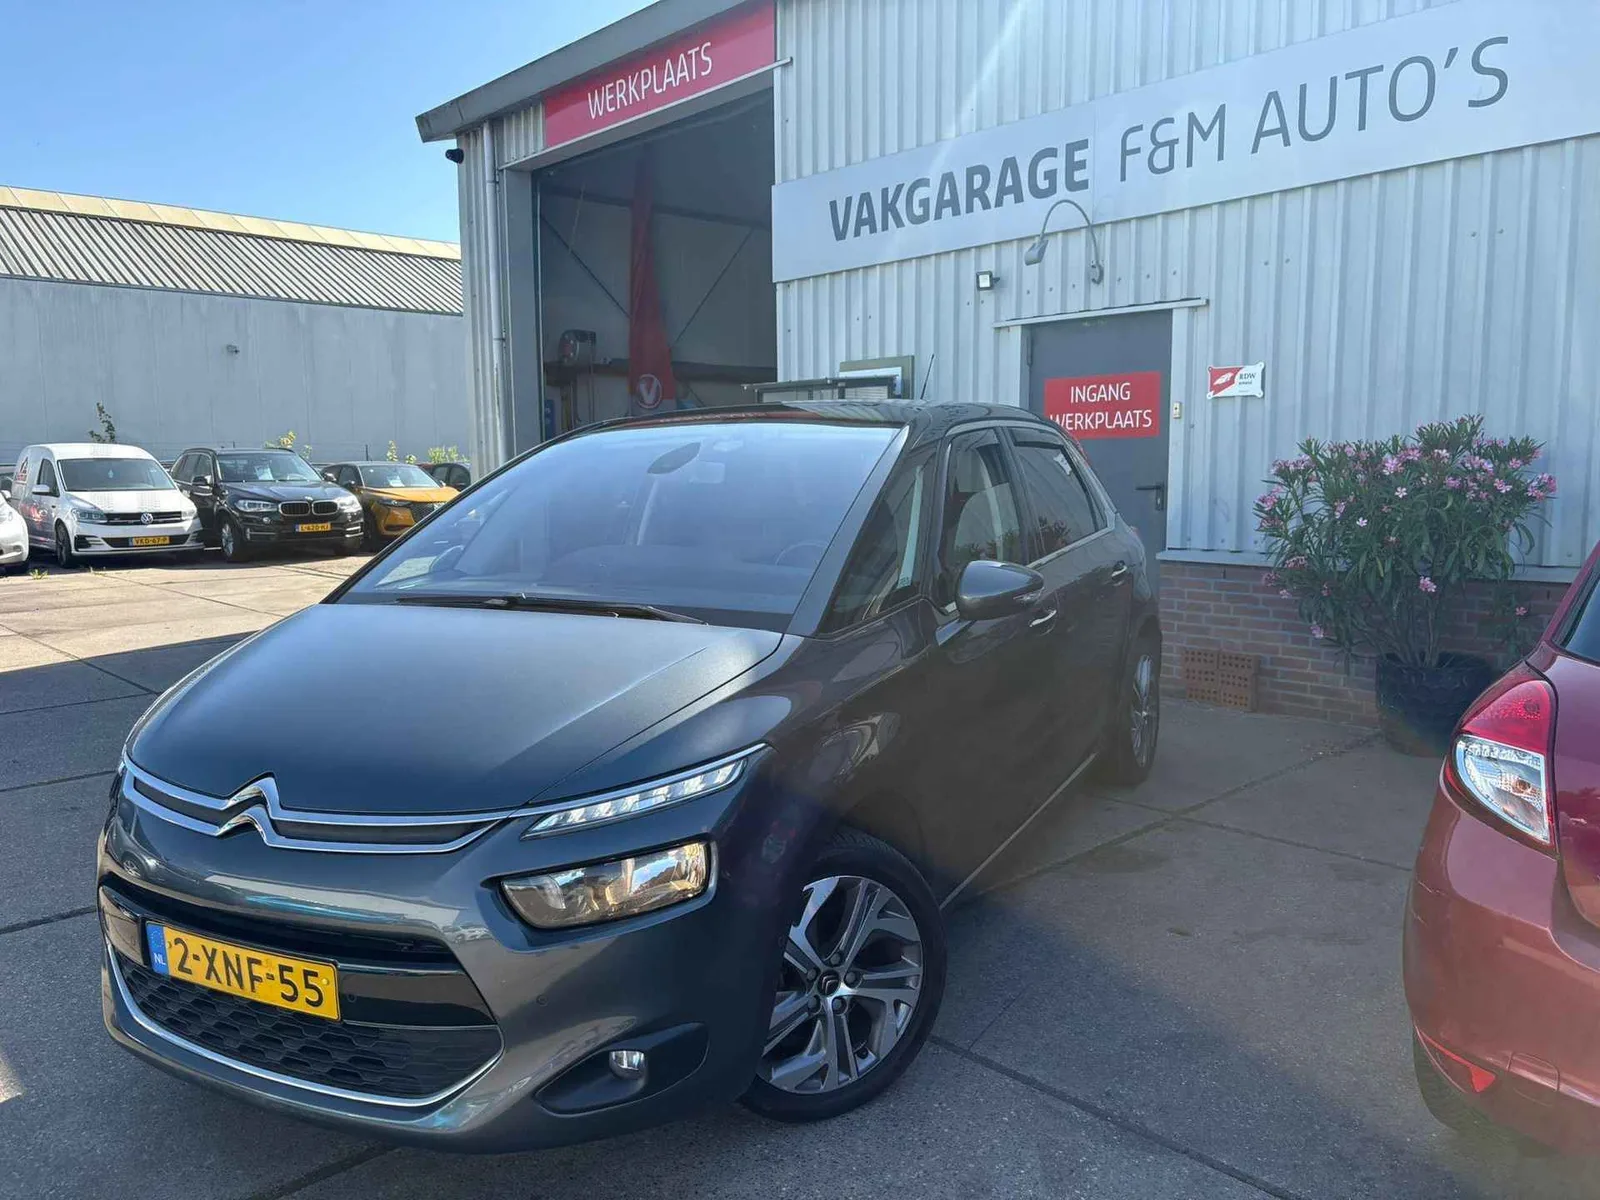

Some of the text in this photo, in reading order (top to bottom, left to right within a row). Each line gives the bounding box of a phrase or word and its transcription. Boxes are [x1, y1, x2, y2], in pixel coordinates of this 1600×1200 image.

[587, 41, 713, 120] WERKPLAATS
[829, 36, 1509, 241] VAKGARAGE F&M AUTO'S
[1070, 382, 1131, 404] INGANG
[154, 937, 324, 1008] NL 2-XNF-55
